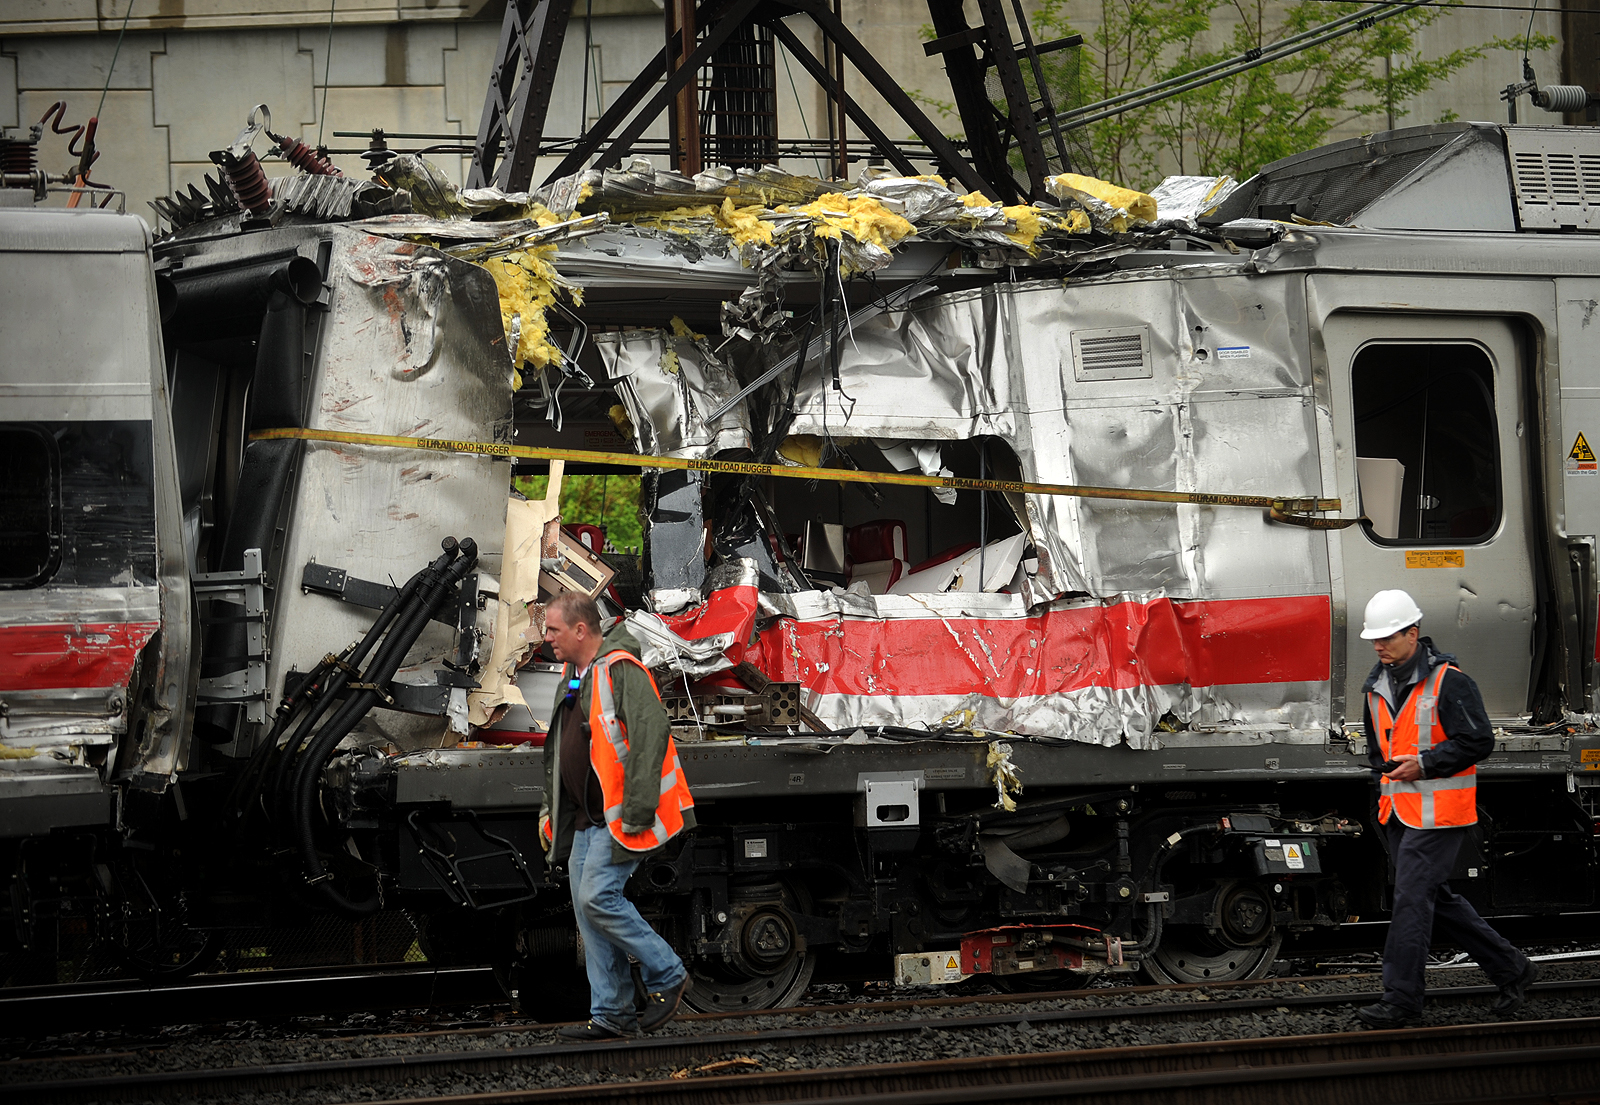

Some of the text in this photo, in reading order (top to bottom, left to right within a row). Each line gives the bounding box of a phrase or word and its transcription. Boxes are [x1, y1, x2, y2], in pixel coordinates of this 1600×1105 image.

[452, 442, 475, 452] LOAD
[476, 444, 510, 454] HUGGER
[720, 462, 740, 471] LOAD
[741, 464, 772, 474] HUGGER
[974, 480, 994, 489] LOAD
[994, 482, 1025, 492] HUGGER
[1218, 496, 1237, 504] LOAD
[1238, 497, 1268, 505] HUGGER
